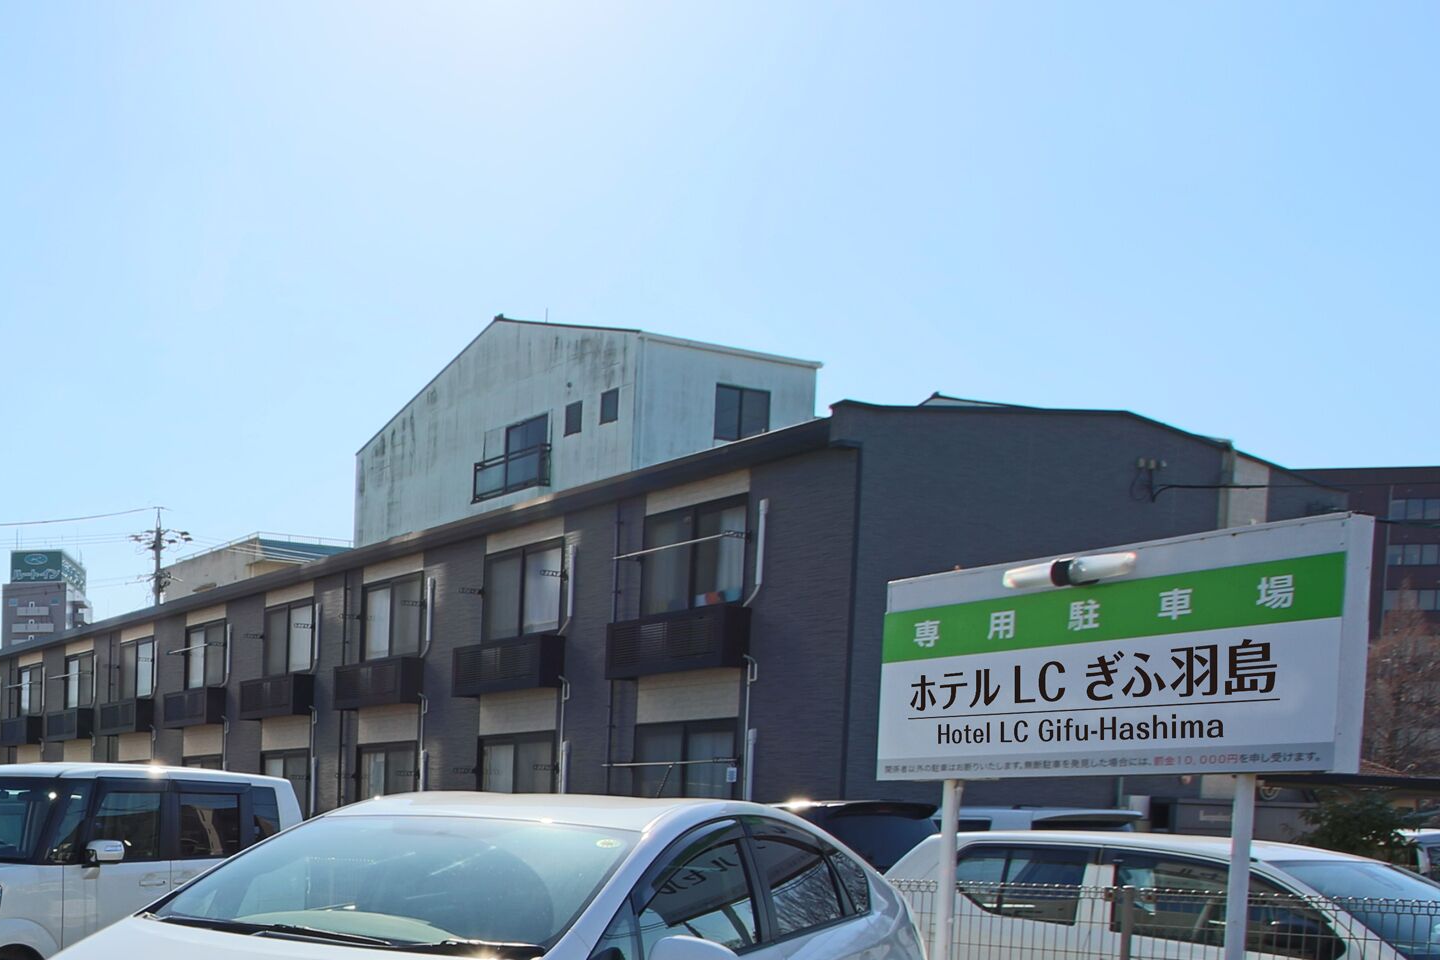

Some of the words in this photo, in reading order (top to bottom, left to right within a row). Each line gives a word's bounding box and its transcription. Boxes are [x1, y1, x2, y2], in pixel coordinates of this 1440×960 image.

[913, 574, 1294, 649] 専用駐車場
[909, 667, 1001, 712] ホテル
[1014, 660, 1066, 704] LC
[1085, 638, 1278, 702] ぎふ羽島
[937, 720, 991, 745] Hotel
[1000, 720, 1029, 743] LC
[1038, 713, 1225, 742] Gifu-Hashima
